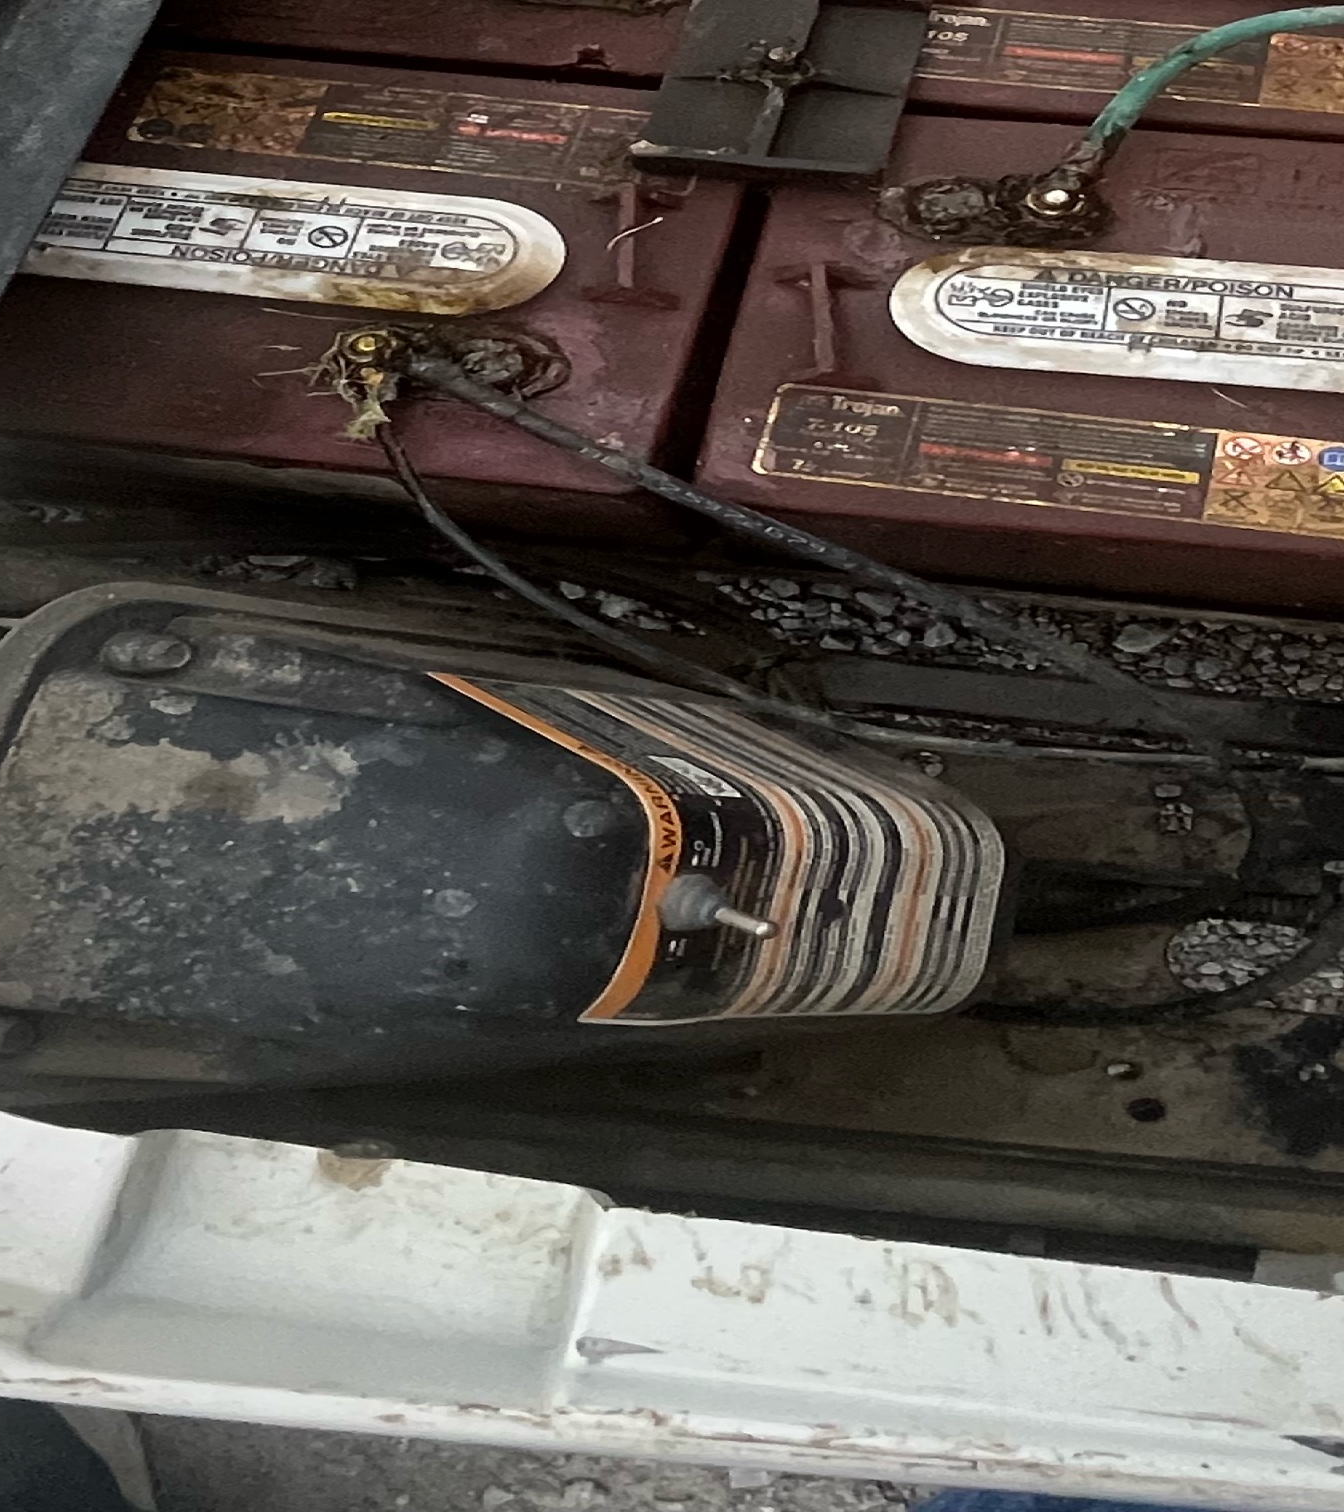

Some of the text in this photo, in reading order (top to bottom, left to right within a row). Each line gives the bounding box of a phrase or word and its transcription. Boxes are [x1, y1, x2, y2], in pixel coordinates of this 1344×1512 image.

[927, 30, 969, 42] 105
[172, 245, 376, 275] DANGER/POISON
[1067, 271, 1295, 299] DANGER/POISON
[832, 395, 905, 418] Trojan
[806, 417, 880, 437] T-105
